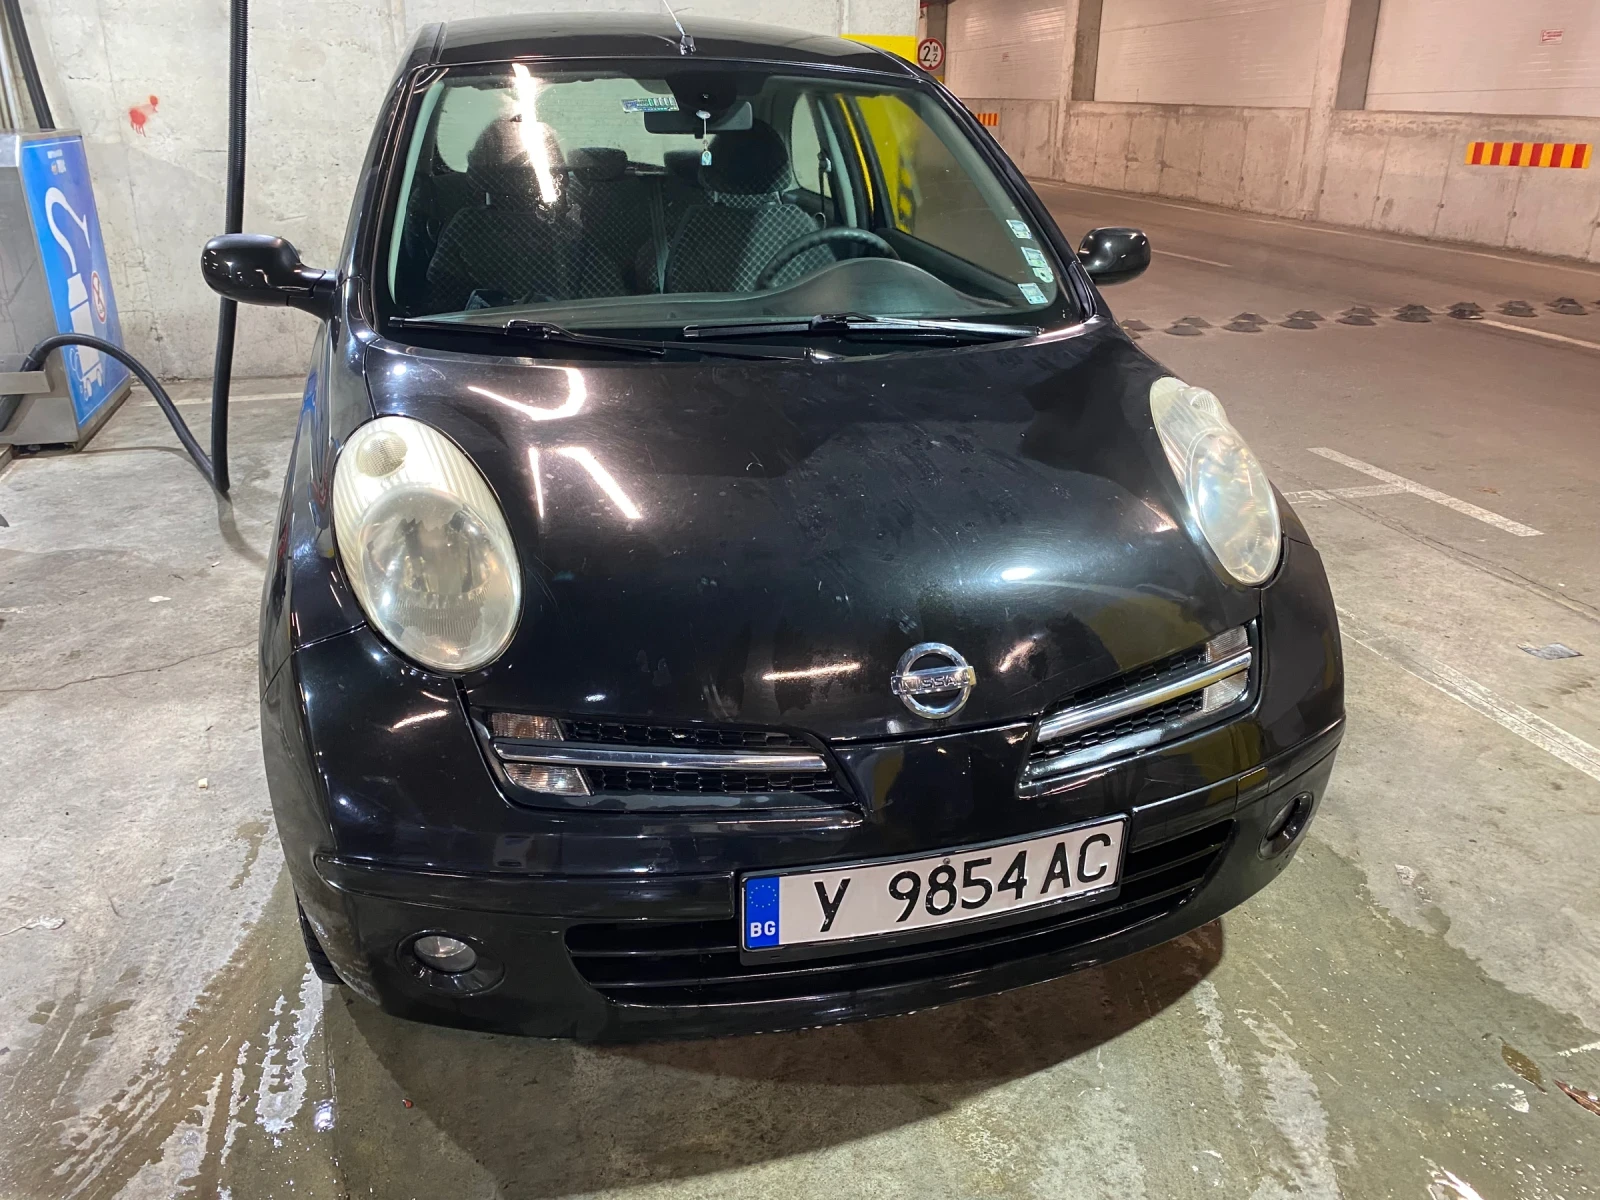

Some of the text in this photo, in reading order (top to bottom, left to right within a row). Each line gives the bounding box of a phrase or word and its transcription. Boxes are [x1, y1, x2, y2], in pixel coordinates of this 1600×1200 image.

[888, 850, 1028, 923] 9854
[1040, 833, 1112, 894] AC
[750, 921, 776, 938] BG
